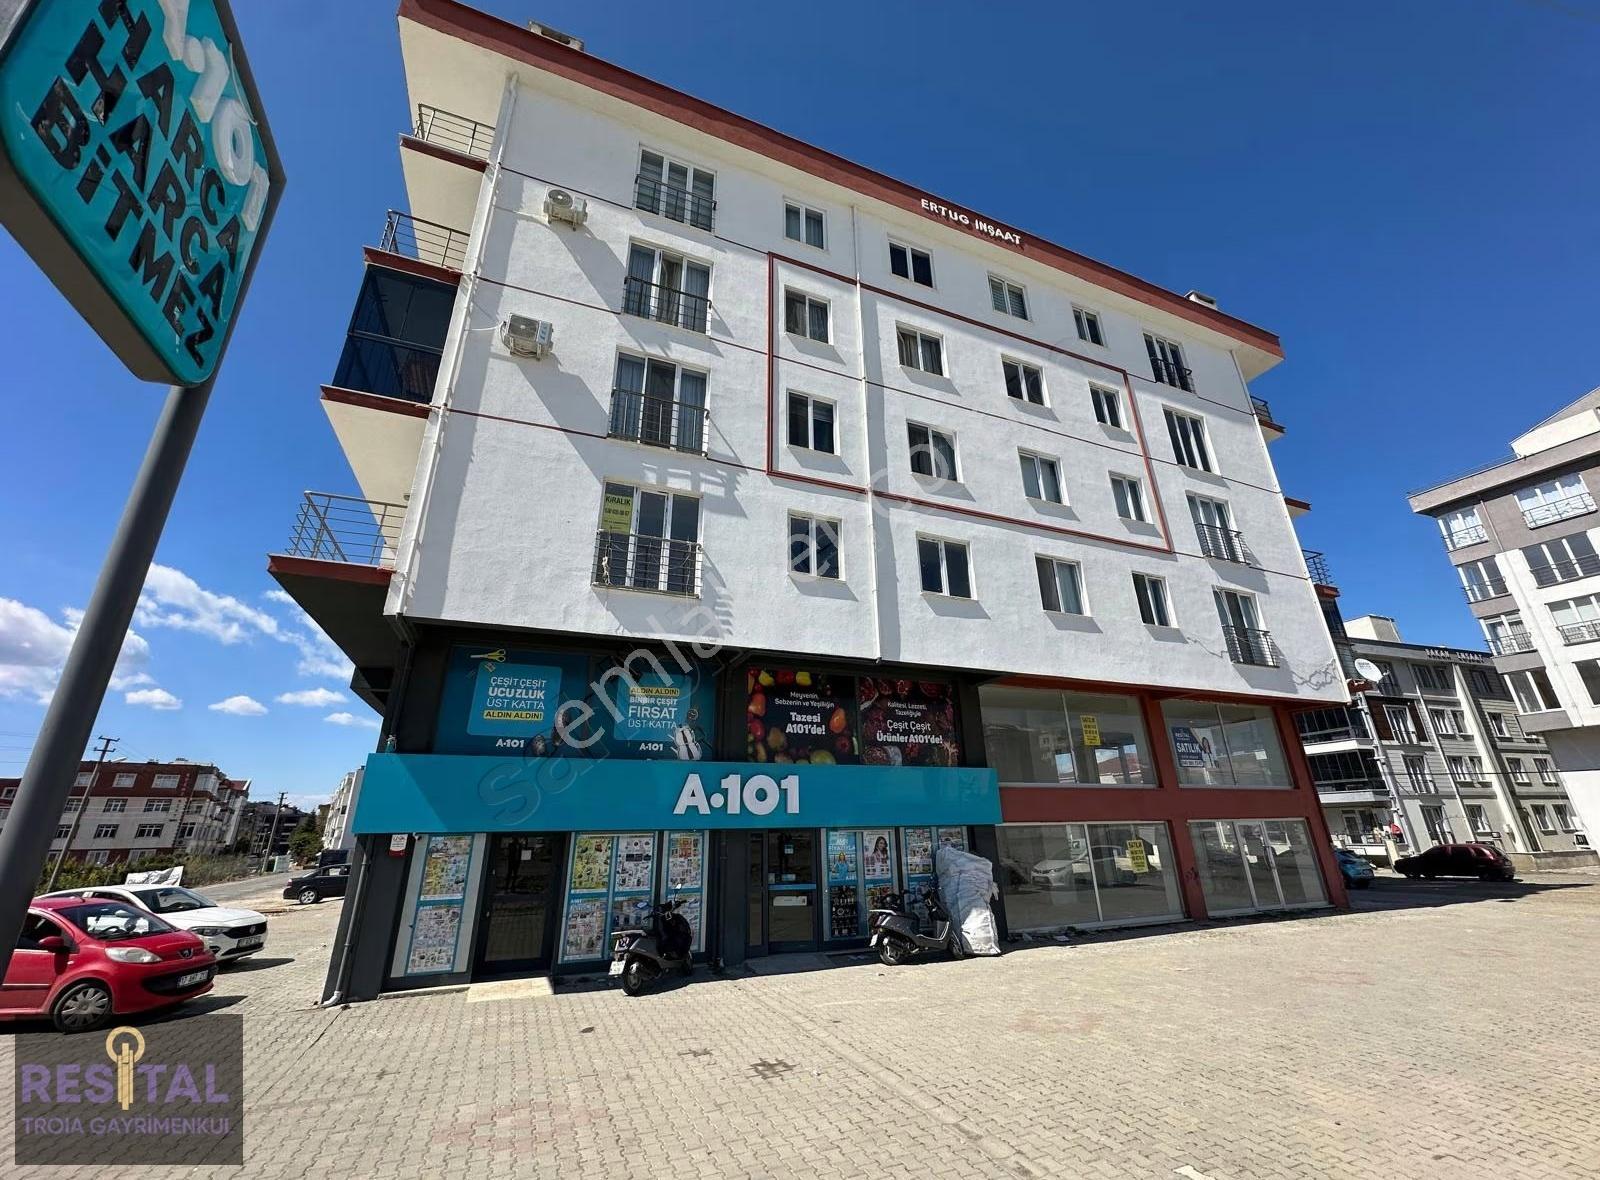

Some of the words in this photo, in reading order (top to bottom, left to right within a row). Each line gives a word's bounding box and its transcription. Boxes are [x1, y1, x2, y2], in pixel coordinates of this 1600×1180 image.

[98, 0, 241, 274] HARCA
[65, 19, 226, 322] HARCA
[920, 198, 970, 225] ERTUG
[30, 75, 215, 369] BİTMEZ
[490, 676, 517, 687] ÇEŞİT
[519, 679, 547, 689] ÇEŞİT
[488, 687, 545, 699] UCUZLUK
[487, 697, 509, 708] ÜST
[511, 700, 545, 709] KATTA
[656, 697, 678, 706] ÇEŞİT
[774, 698, 802, 706] Sebzenin
[514, 712, 542, 720] ALDIN!
[628, 706, 678, 719] FIRSAT
[790, 712, 821, 723] Tazesi
[628, 719, 647, 728] ÜST
[649, 720, 678, 729] KATTA
[886, 719, 909, 732] Çeşit
[909, 720, 931, 733] Çeşit
[876, 730, 908, 742] Ürünler
[1176, 742, 1201, 753] SATILIK
